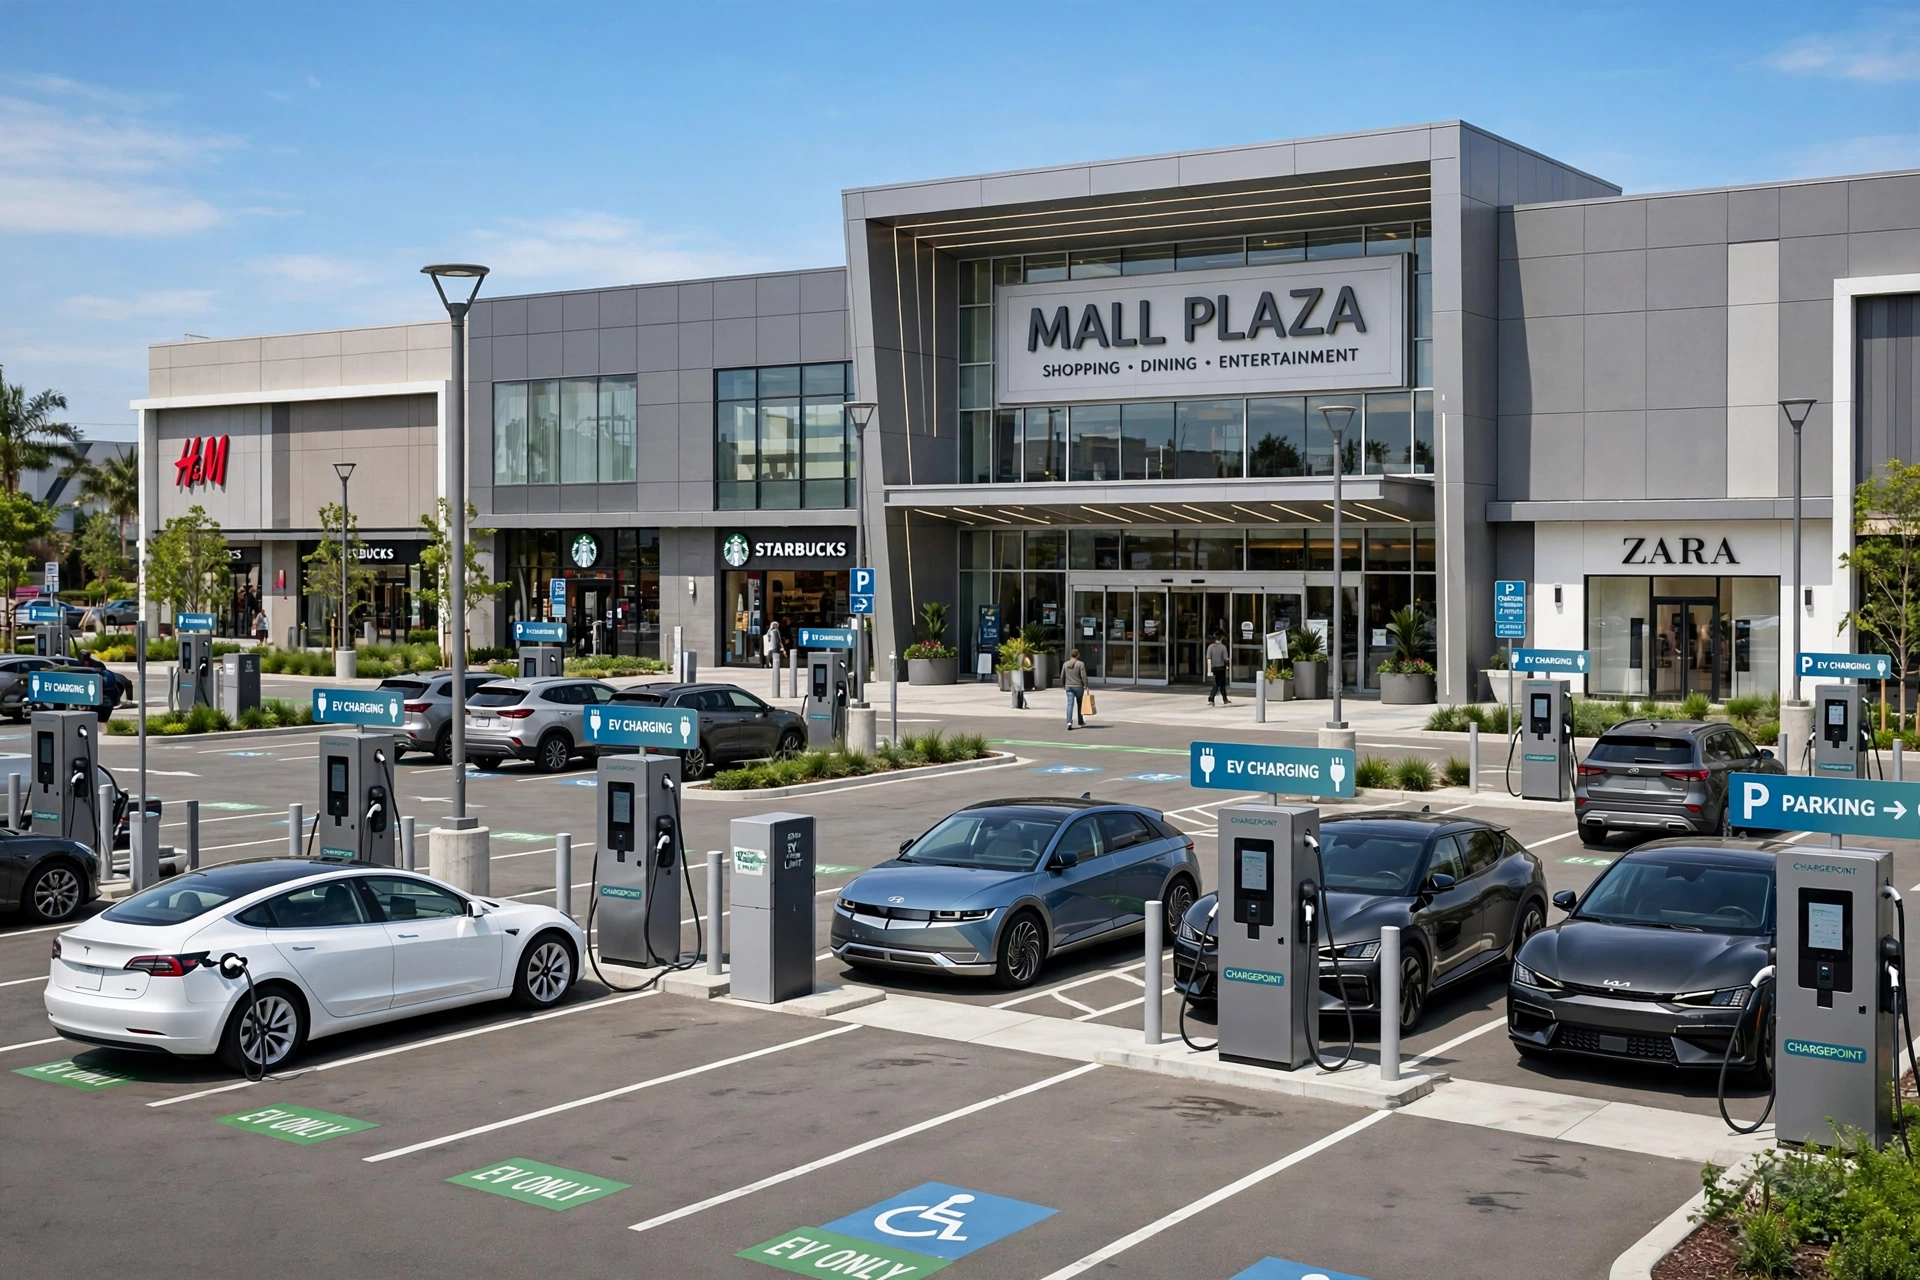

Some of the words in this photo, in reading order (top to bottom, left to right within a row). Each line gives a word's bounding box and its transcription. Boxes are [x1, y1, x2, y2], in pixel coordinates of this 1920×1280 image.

[1027, 299, 1166, 353] MALL
[1184, 285, 1367, 343] PLAZA
[1042, 360, 1121, 378] SHOPPING
[1140, 356, 1198, 374] DINING
[1219, 347, 1360, 369] ENTERTAINMENT
[174, 434, 230, 488] H&M
[755, 541, 847, 557] STARBUCKS
[1621, 536, 1741, 565] ZARA
[856, 571, 870, 593] P
[1505, 583, 1515, 595] P
[1801, 656, 1813, 673] P
[1817, 661, 1828, 669] EV
[1829, 661, 1871, 671] CHARGING
[332, 700, 343, 711] EV
[344, 701, 384, 714] CHARGING
[608, 718, 621, 731] EV
[622, 719, 673, 734] CHARGING
[1227, 759, 1244, 774] EV
[1247, 760, 1320, 779] CHARGING
[1743, 781, 1770, 820] P
[1782, 794, 1875, 817] PARKING
[1230, 816, 1278, 827] CHARGEPOINT
[1793, 863, 1858, 875] CHARGEPOINT
[1225, 969, 1282, 983] CHARGEPOINT
[1787, 1042, 1864, 1060] CHARGEPOINT
[236, 1108, 296, 1125] EV
[269, 1117, 351, 1138] ONLY
[471, 1165, 535, 1184] EV
[511, 1175, 602, 1202] ONLY
[762, 1236, 832, 1260] EV
[814, 1249, 918, 1280] ONLY
